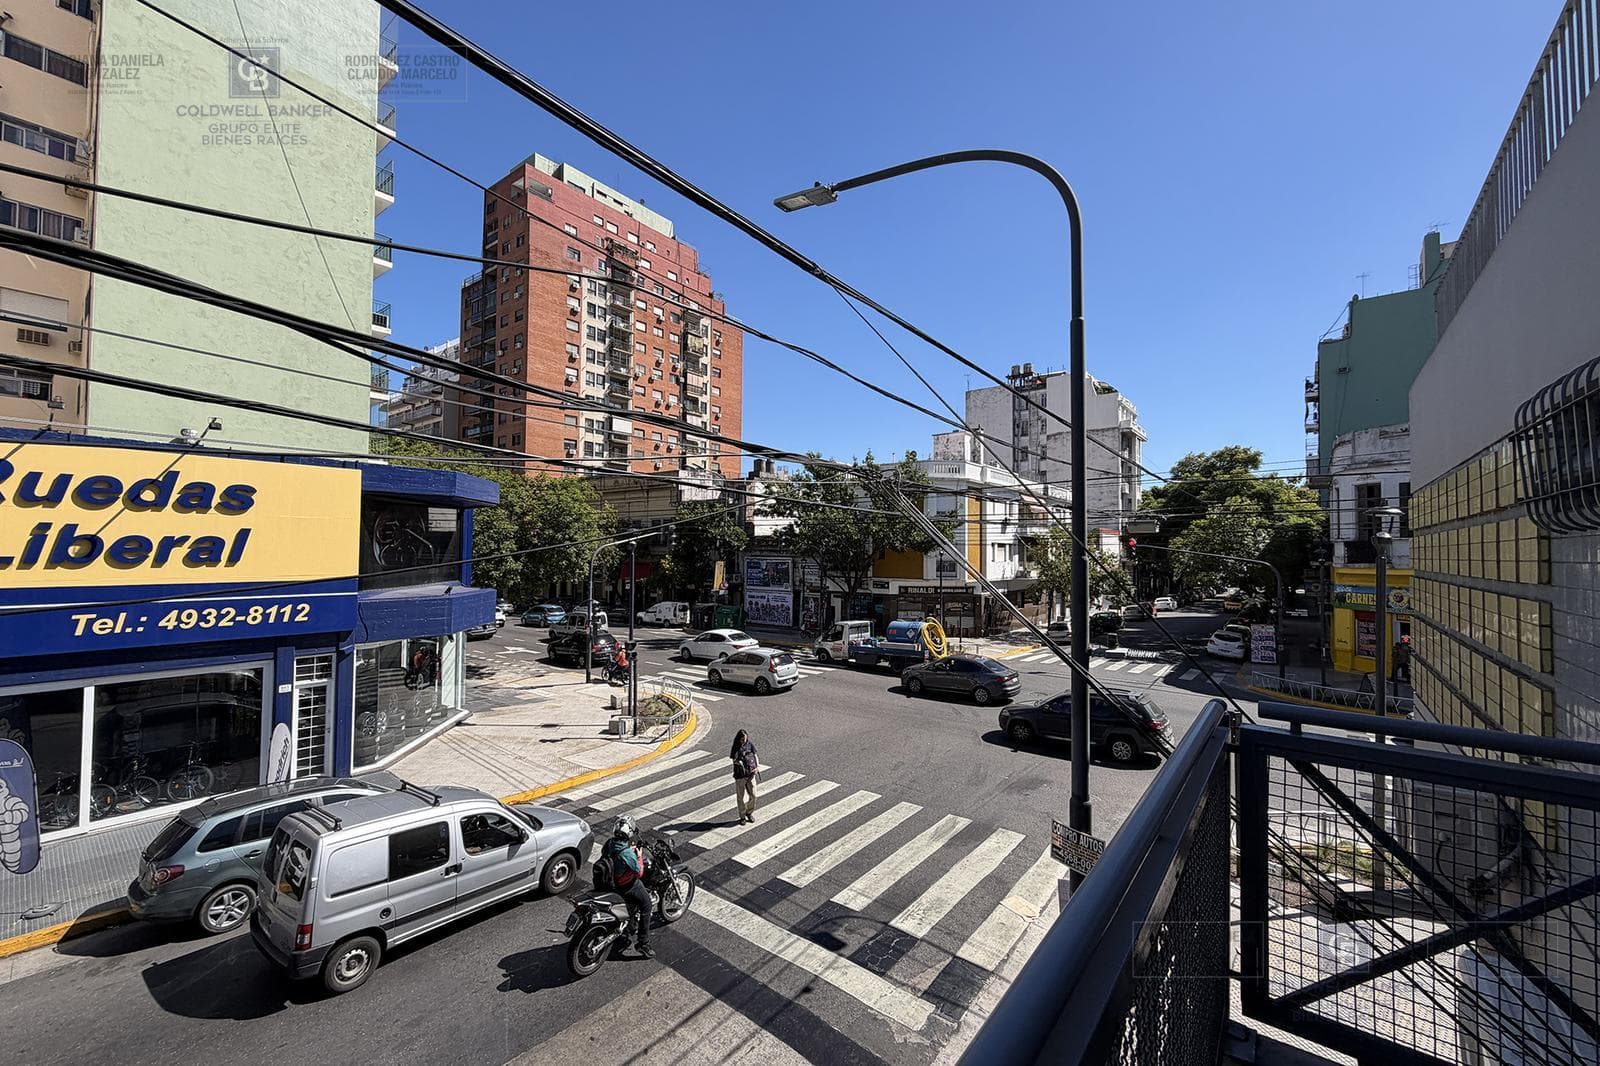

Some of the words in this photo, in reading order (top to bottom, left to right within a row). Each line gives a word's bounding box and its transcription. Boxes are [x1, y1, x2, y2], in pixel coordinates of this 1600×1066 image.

[0, 522, 252, 570] iberal
[71, 612, 148, 636] Tel.:
[158, 603, 311, 630] 4932-8112
[1079, 834, 1104, 854] AUTOS
